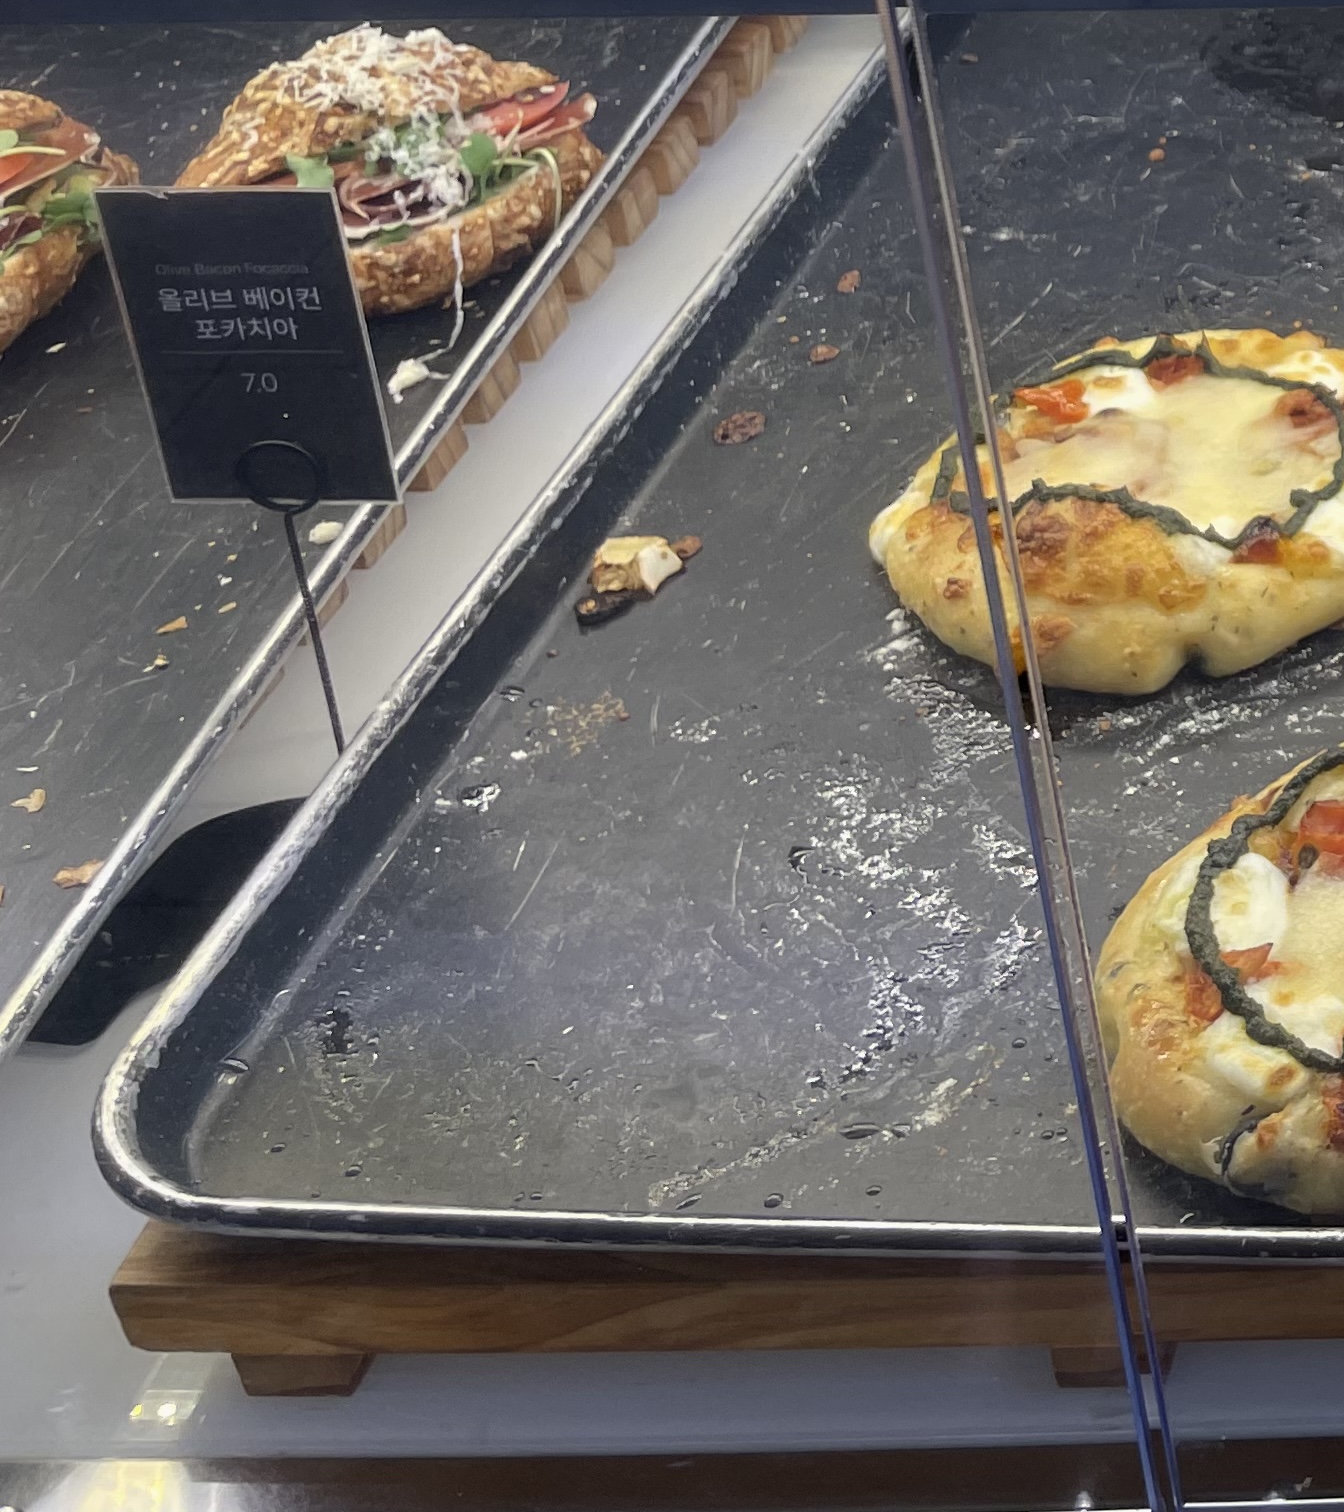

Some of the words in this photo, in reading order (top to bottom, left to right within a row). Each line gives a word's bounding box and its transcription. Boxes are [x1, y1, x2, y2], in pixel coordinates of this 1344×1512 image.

[157, 287, 237, 313] 올리브
[242, 286, 323, 312] 베이컨
[195, 316, 299, 341] 포카치아
[240, 372, 279, 394] 7.0
